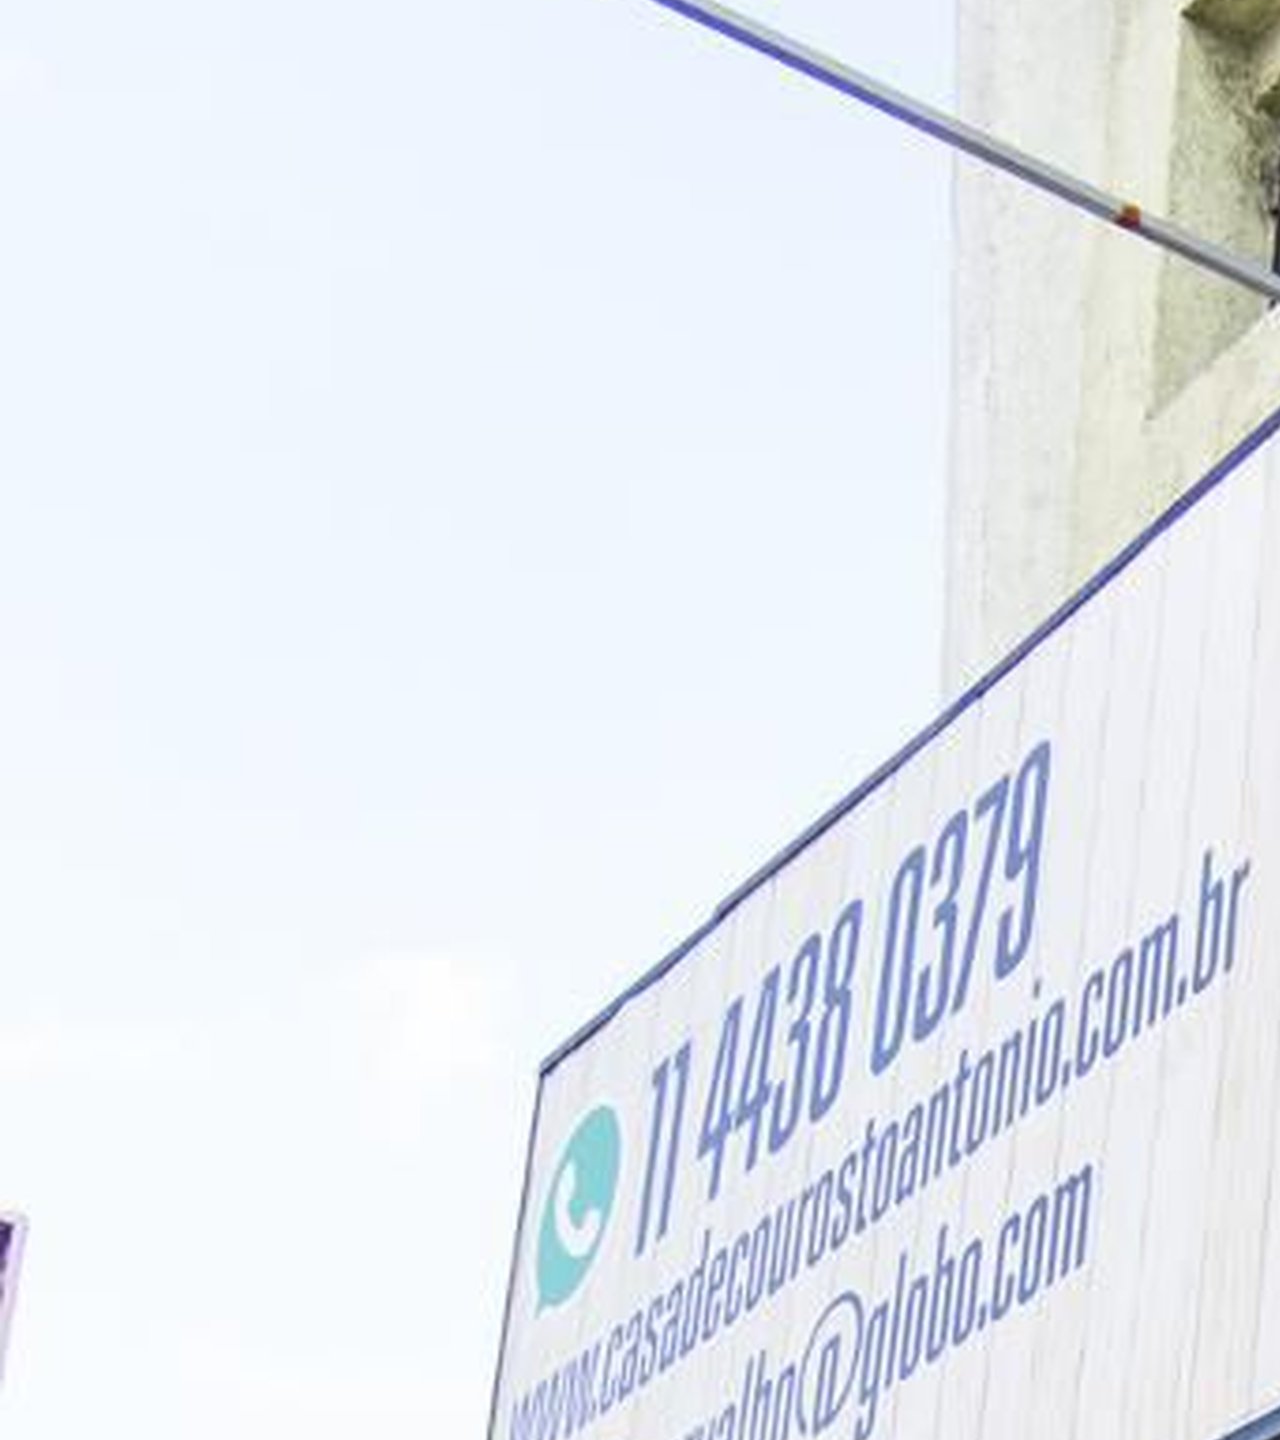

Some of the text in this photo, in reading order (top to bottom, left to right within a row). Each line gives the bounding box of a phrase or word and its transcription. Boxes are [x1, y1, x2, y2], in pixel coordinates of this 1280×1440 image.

[634, 739, 1052, 1260] 11 4438 0379
